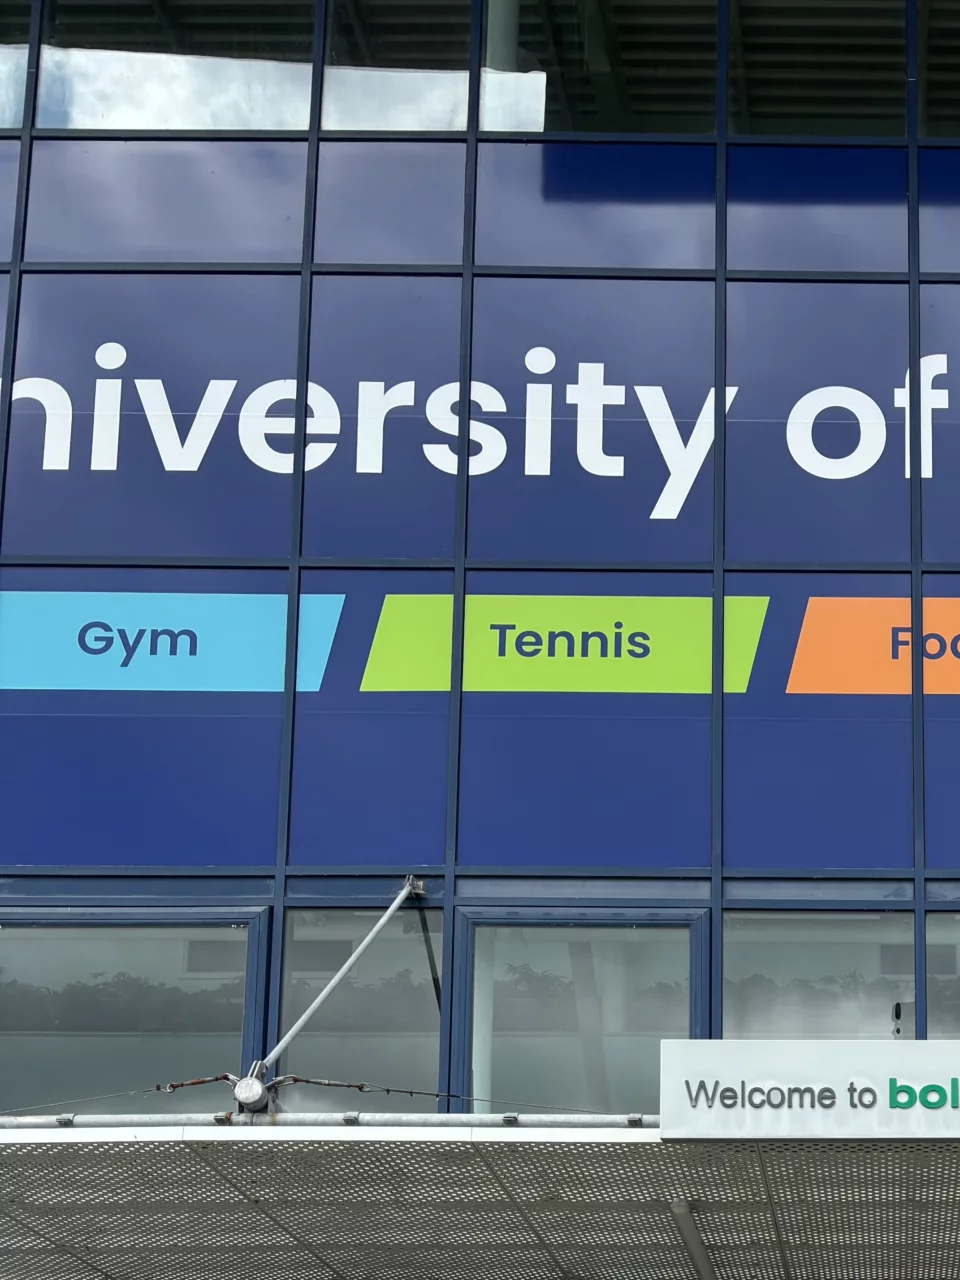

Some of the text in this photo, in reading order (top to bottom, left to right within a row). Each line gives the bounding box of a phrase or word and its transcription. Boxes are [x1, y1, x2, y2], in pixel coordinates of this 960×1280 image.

[786, 353, 949, 480] of
[77, 620, 199, 667] Gym
[489, 621, 652, 660] Tennis
[684, 1079, 837, 1109] Welcome
[847, 1080, 878, 1109] to
